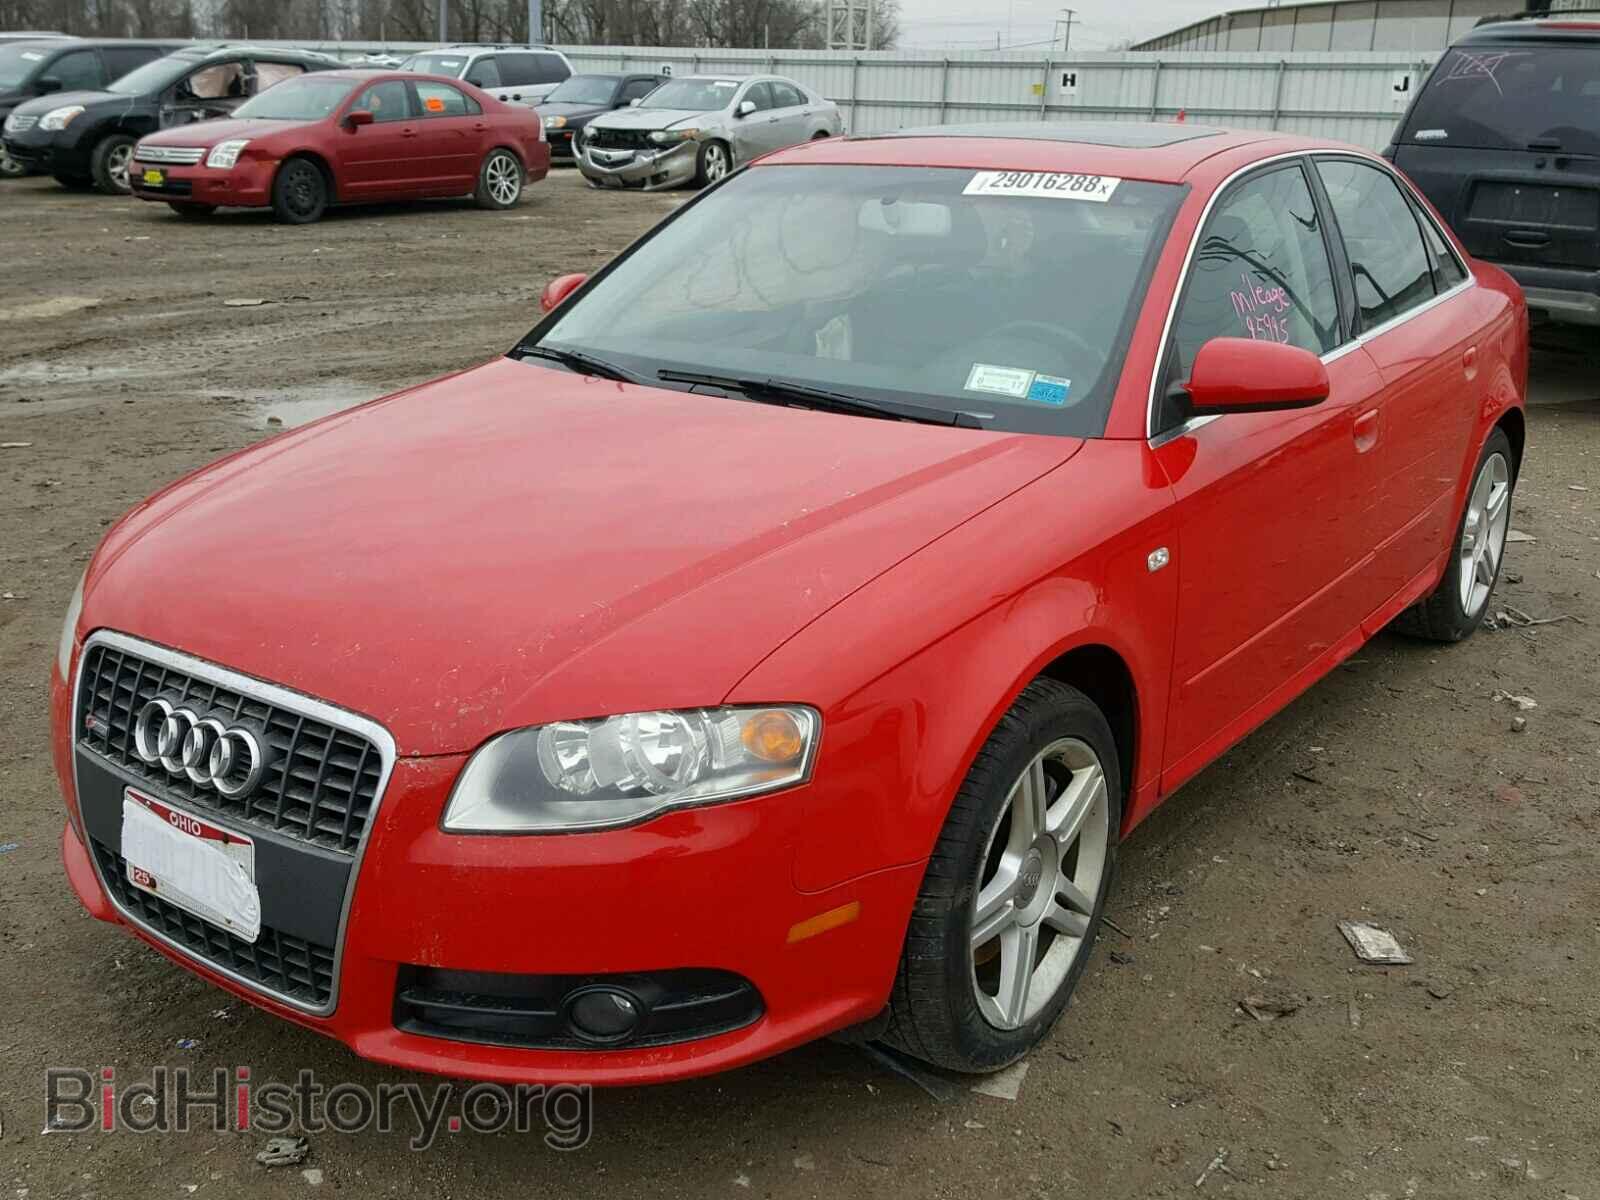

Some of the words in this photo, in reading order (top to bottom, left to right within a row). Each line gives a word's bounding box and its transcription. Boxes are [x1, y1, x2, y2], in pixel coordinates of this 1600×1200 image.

[1062, 73, 1076, 87] H
[1394, 76, 1409, 92] J
[168, 811, 201, 836] OHIO
[135, 868, 150, 886] 25
